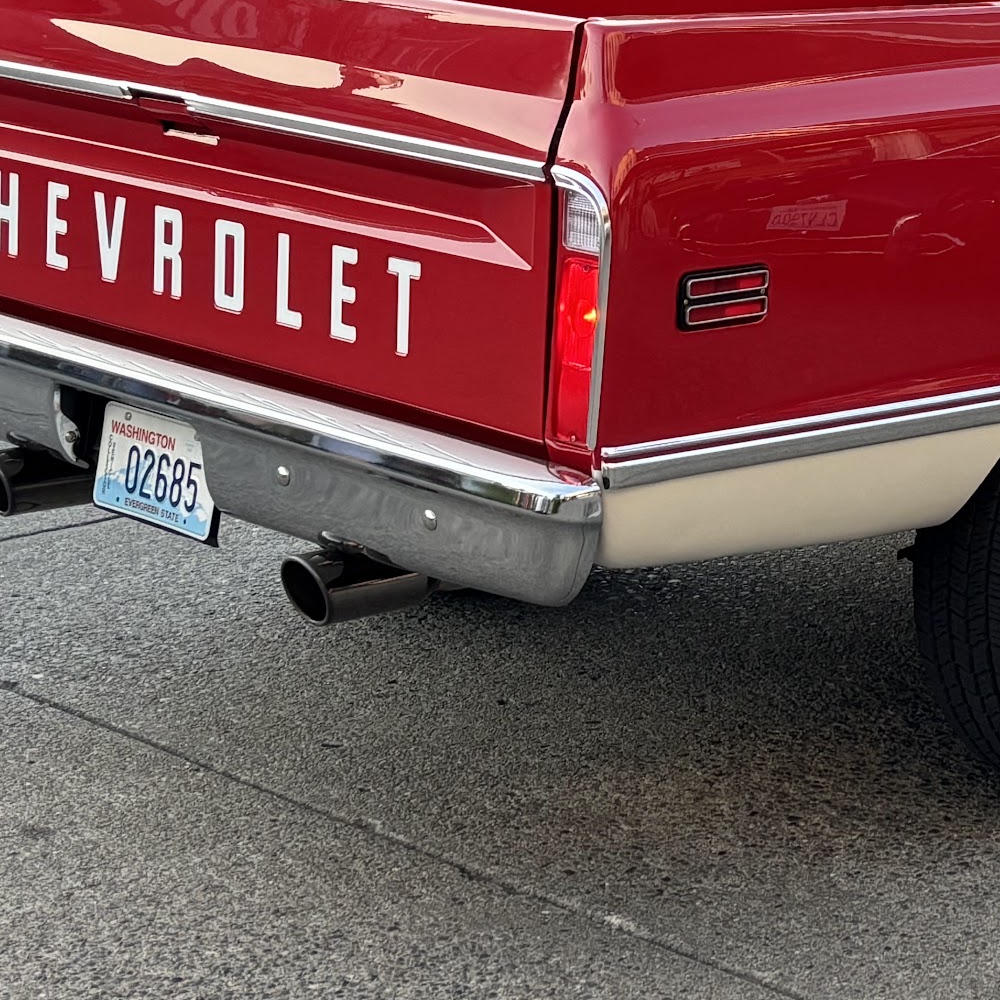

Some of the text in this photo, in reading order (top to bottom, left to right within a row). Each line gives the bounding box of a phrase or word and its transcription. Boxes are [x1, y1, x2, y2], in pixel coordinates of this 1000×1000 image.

[0, 171, 422, 358] HEVROLET
[111, 420, 176, 452] WASHINGTON
[124, 444, 202, 513] 02685
[124, 496, 180, 523] EVERGREEN STATE
